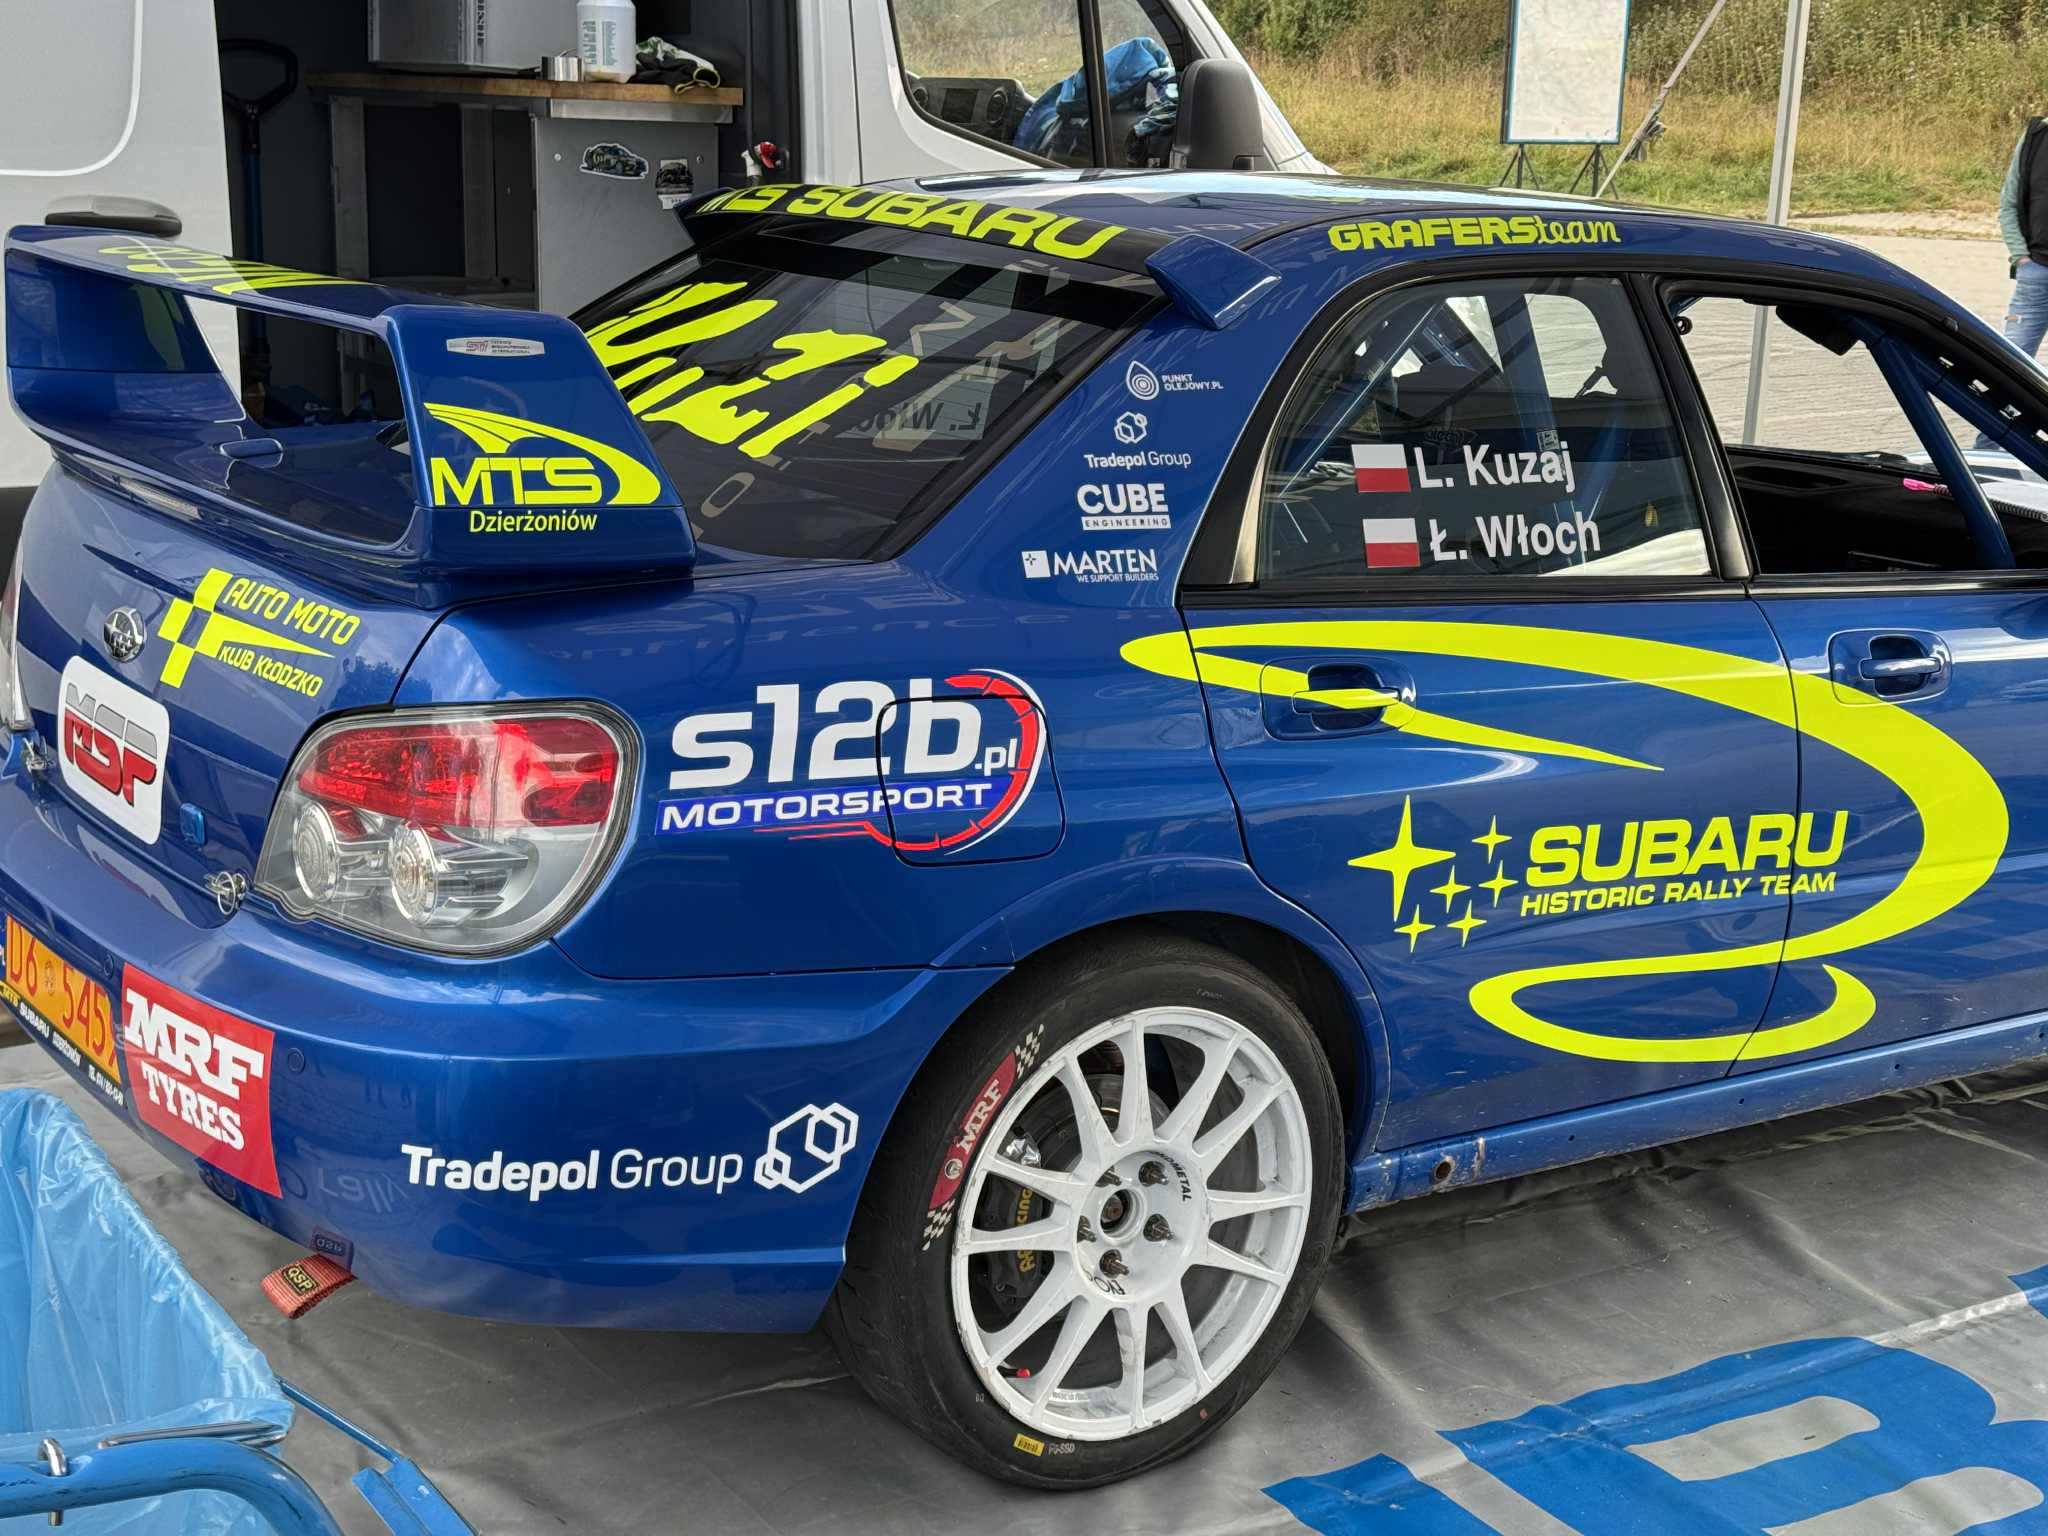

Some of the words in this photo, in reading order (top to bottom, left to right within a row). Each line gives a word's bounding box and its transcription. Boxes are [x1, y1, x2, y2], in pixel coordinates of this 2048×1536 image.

[786, 186, 1129, 260] SUBARU
[1161, 373, 1193, 382] PUNKT
[1163, 381, 1224, 391] OLEJOWY.PL
[430, 457, 602, 505] MTS
[1084, 451, 1146, 470] Tradepol
[1148, 451, 1192, 469] Group
[1413, 446, 1455, 488] L.
[1462, 440, 1576, 493] Kuzaj
[469, 508, 598, 532] Dzierżoniów
[1077, 483, 1169, 514] CUBE
[1085, 518, 1168, 528] ENGINEERING
[1428, 519, 1468, 561] Ł.
[1475, 510, 1601, 559] Włoch
[1054, 548, 1158, 576] MARTEN
[1076, 574, 1089, 583] WE
[1090, 573, 1123, 582] SUPPORT
[1125, 572, 1160, 582] BUILDERS
[223, 577, 290, 620] AUTO
[282, 598, 361, 645] MOTO
[218, 646, 253, 671] KLUB
[252, 655, 324, 697] KŁODZKO
[661, 783, 993, 831] MOTORSPORT
[1525, 810, 1849, 888] SUBARU
[1521, 884, 1655, 917] HISTORIC
[1662, 877, 1752, 904] RALLY
[1759, 871, 1838, 896] TEAM
[10, 920, 38, 998] D6
[124, 987, 265, 1100] MRF
[141, 1060, 245, 1151] TYRES
[956, 1078, 1002, 1155] MRF
[400, 1144, 600, 1202] Tradepol
[610, 1148, 745, 1195] Group
[288, 1266, 313, 1292] QSP
